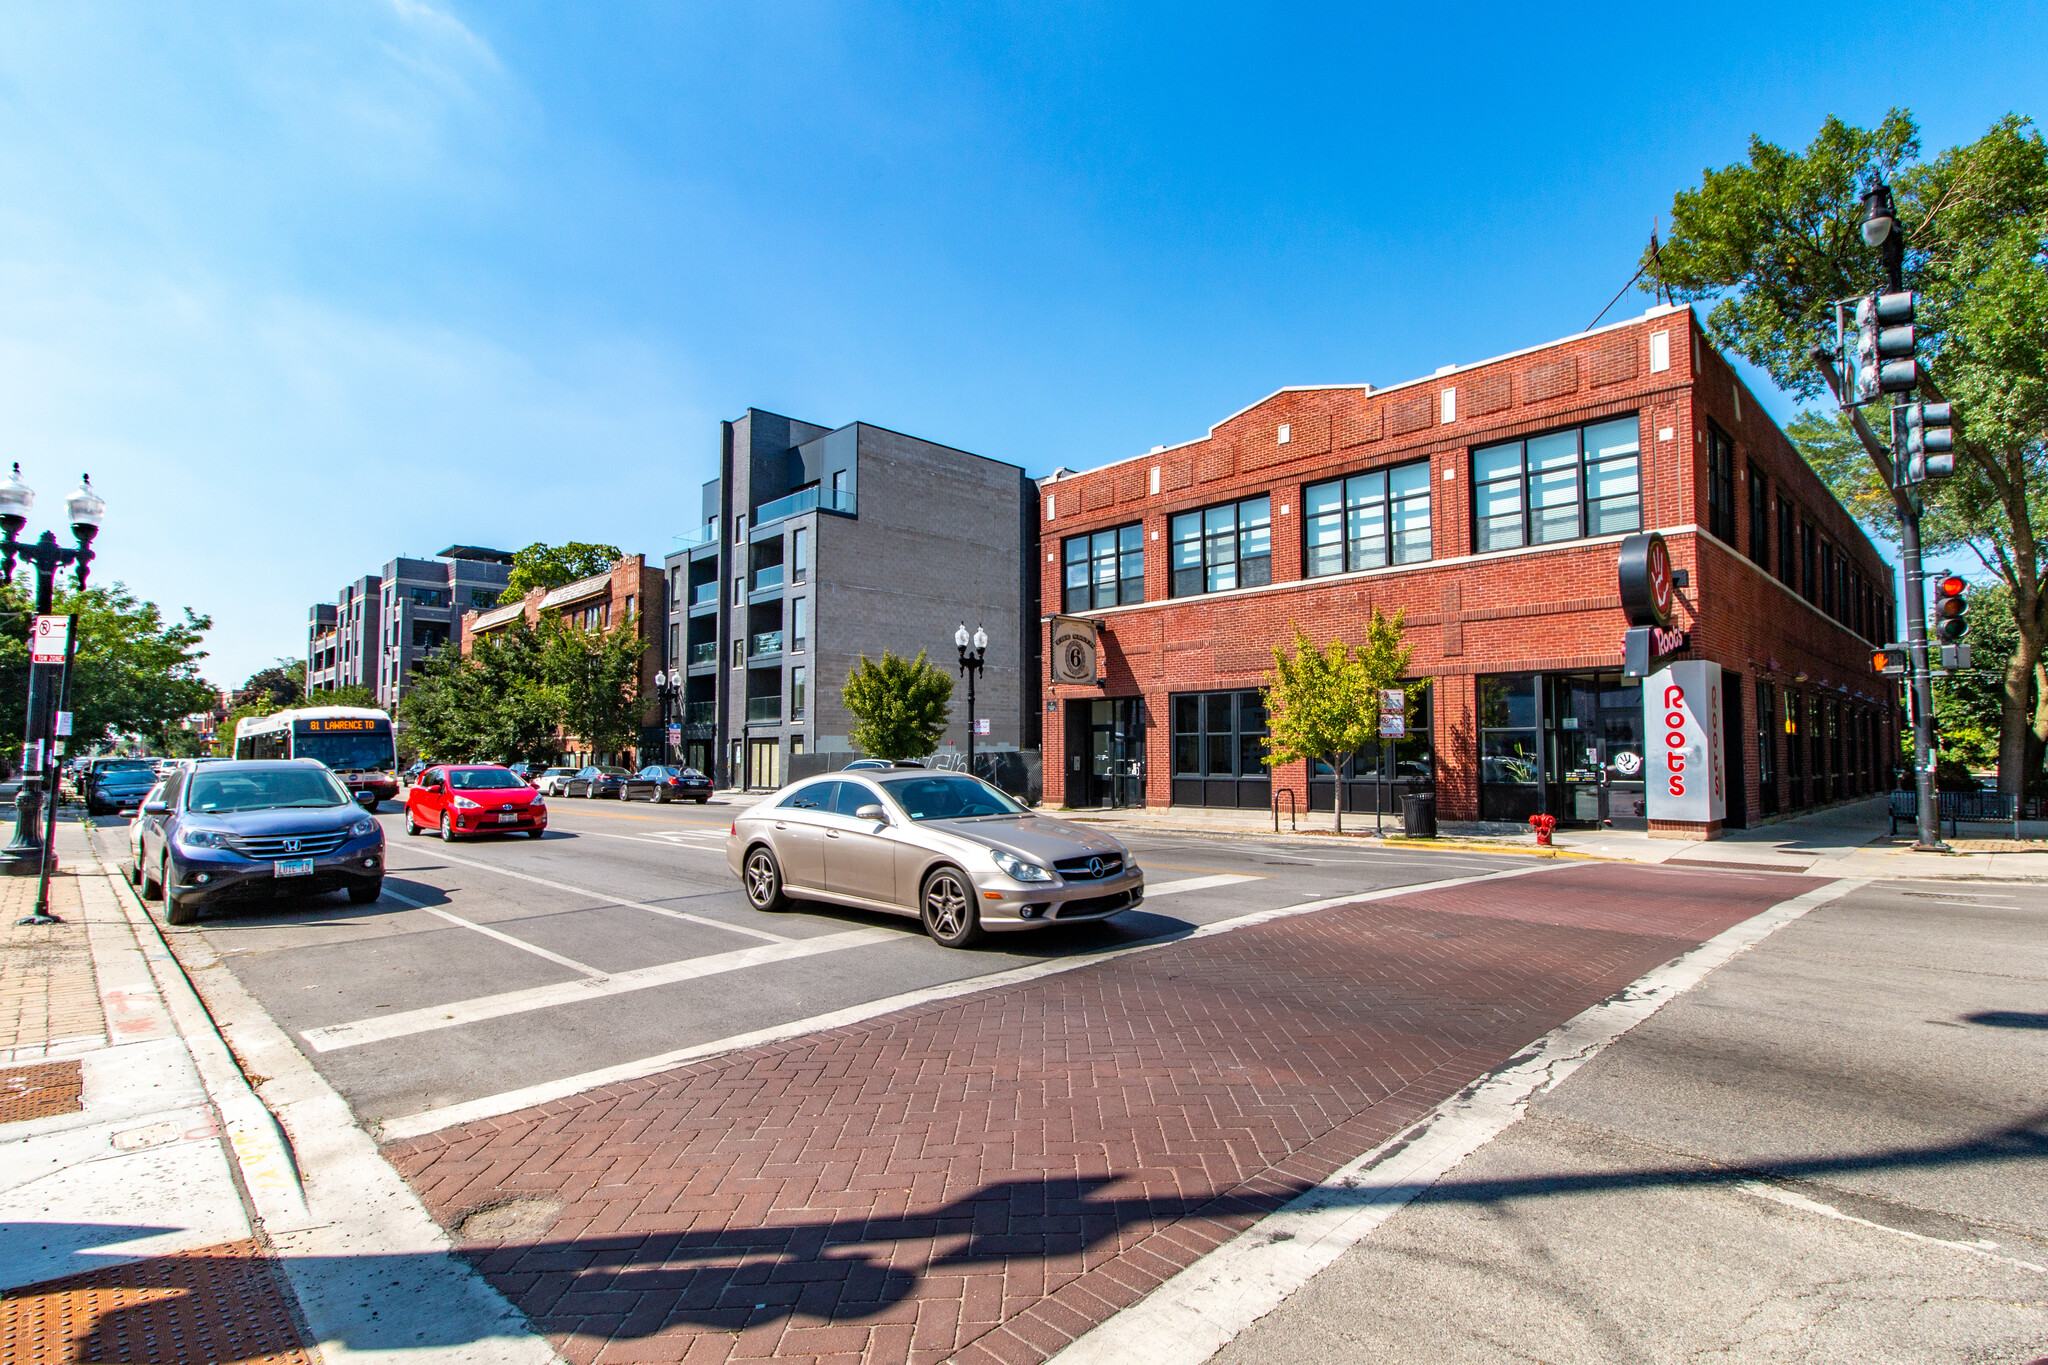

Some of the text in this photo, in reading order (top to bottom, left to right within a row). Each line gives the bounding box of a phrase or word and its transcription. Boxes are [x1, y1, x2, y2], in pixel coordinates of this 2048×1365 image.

[1655, 626, 1683, 656] Roots
[1070, 648, 1081, 667] 6
[310, 720, 375, 730] 81 LAWRENCE TO
